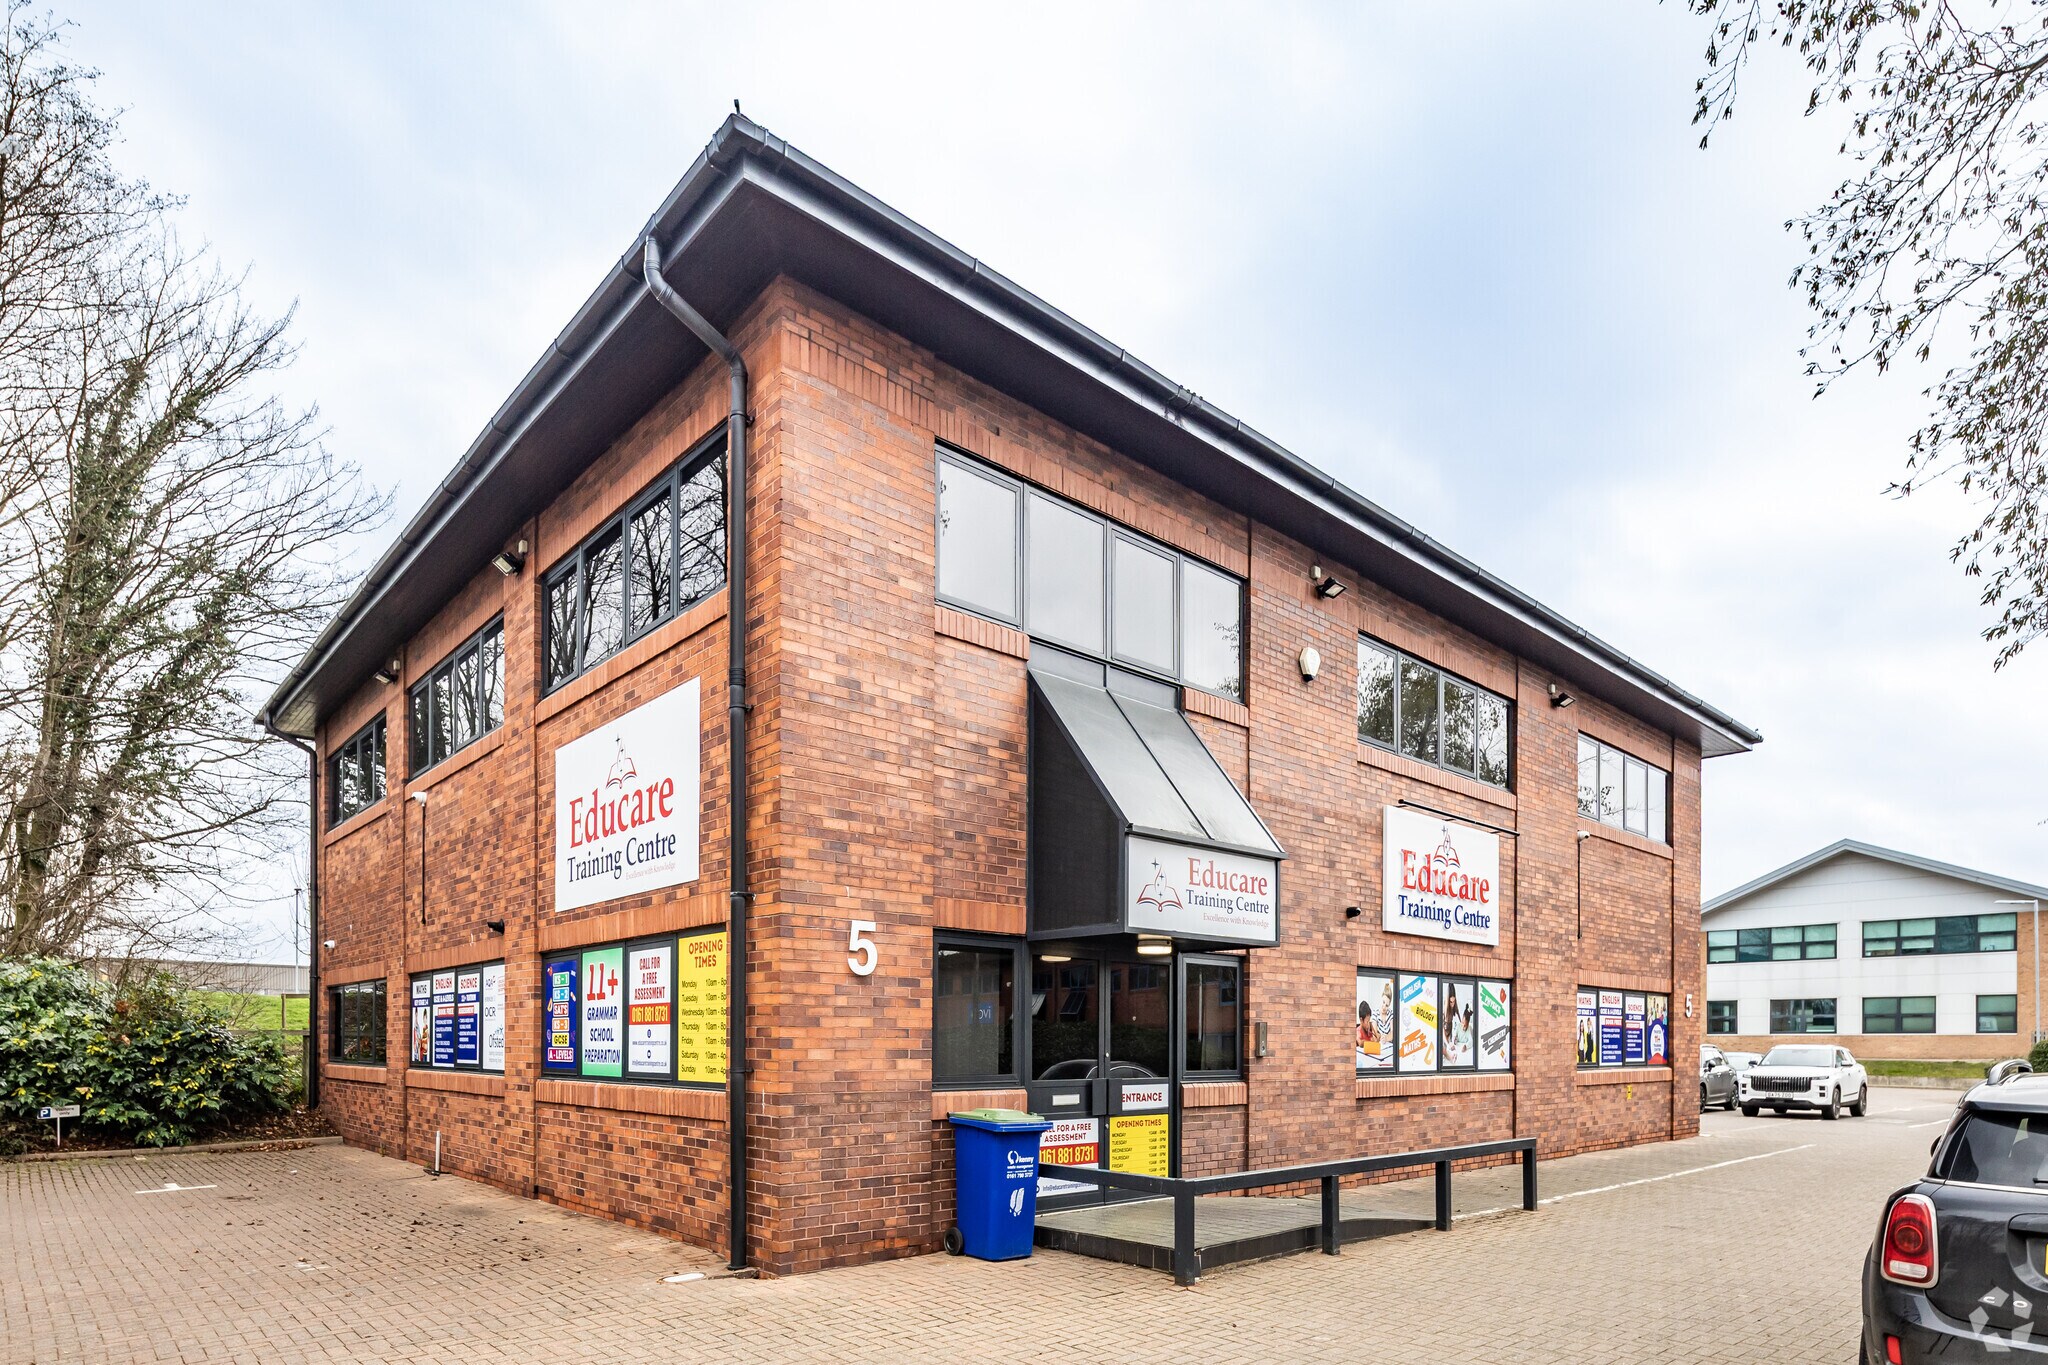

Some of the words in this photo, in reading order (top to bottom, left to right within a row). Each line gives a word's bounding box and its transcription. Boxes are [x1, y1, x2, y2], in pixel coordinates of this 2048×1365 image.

[570, 777, 674, 849] Educare
[567, 849, 622, 883] Training
[626, 833, 676, 866] Centre
[1188, 857, 1267, 896] Educare
[1401, 849, 1489, 904] Educare
[1186, 889, 1233, 914] Training
[1235, 896, 1269, 914] Centre
[1398, 895, 1451, 929] Training
[1455, 905, 1490, 929] Centre
[1203, 913, 1229, 924] Excellence
[1230, 915, 1241, 925] with
[1242, 917, 1269, 929] Knowledge
[688, 939, 723, 955] OPENING
[848, 920, 878, 976] 5
[639, 957, 651, 970] CALL
[652, 956, 660, 969] FOR
[694, 955, 717, 968] TIMES
[435, 977, 452, 989] ENGLISH
[460, 977, 477, 989] SCIENCE
[587, 963, 618, 1001] 11+
[642, 973, 646, 985] A
[646, 971, 657, 984] FREE
[682, 980, 697, 989] Monday
[634, 986, 665, 1000] ASSESSMENT
[682, 994, 698, 1003] Tuesday
[1602, 995, 1621, 1005] ENGLISH
[485, 1007, 496, 1017] OCR
[682, 1009, 704, 1017] Wednesday
[1685, 994, 1693, 1018] 5
[587, 1006, 618, 1021] GRAMMAR
[631, 1008, 643, 1023] 0161
[644, 1007, 654, 1022] 881
[655, 1006, 668, 1022] 8731
[1416, 1007, 1434, 1022] BIOLOGY
[682, 1022, 700, 1032] Thursday
[554, 1035, 567, 1044] GCSE
[590, 1027, 614, 1042] SCHOOL
[681, 1036, 694, 1046] Friday
[584, 1049, 620, 1063] PREPARATION
[681, 1050, 699, 1060] Saturday
[681, 1064, 696, 1074] Sunday
[1121, 1092, 1162, 1102] ENTRANCE
[1076, 1123, 1091, 1131] FREE
[1117, 1120, 1143, 1128] OPENING
[1044, 1133, 1086, 1143] ASSESSMENT
[1058, 1147, 1073, 1163] 881
[1075, 1146, 1094, 1162] 8731
